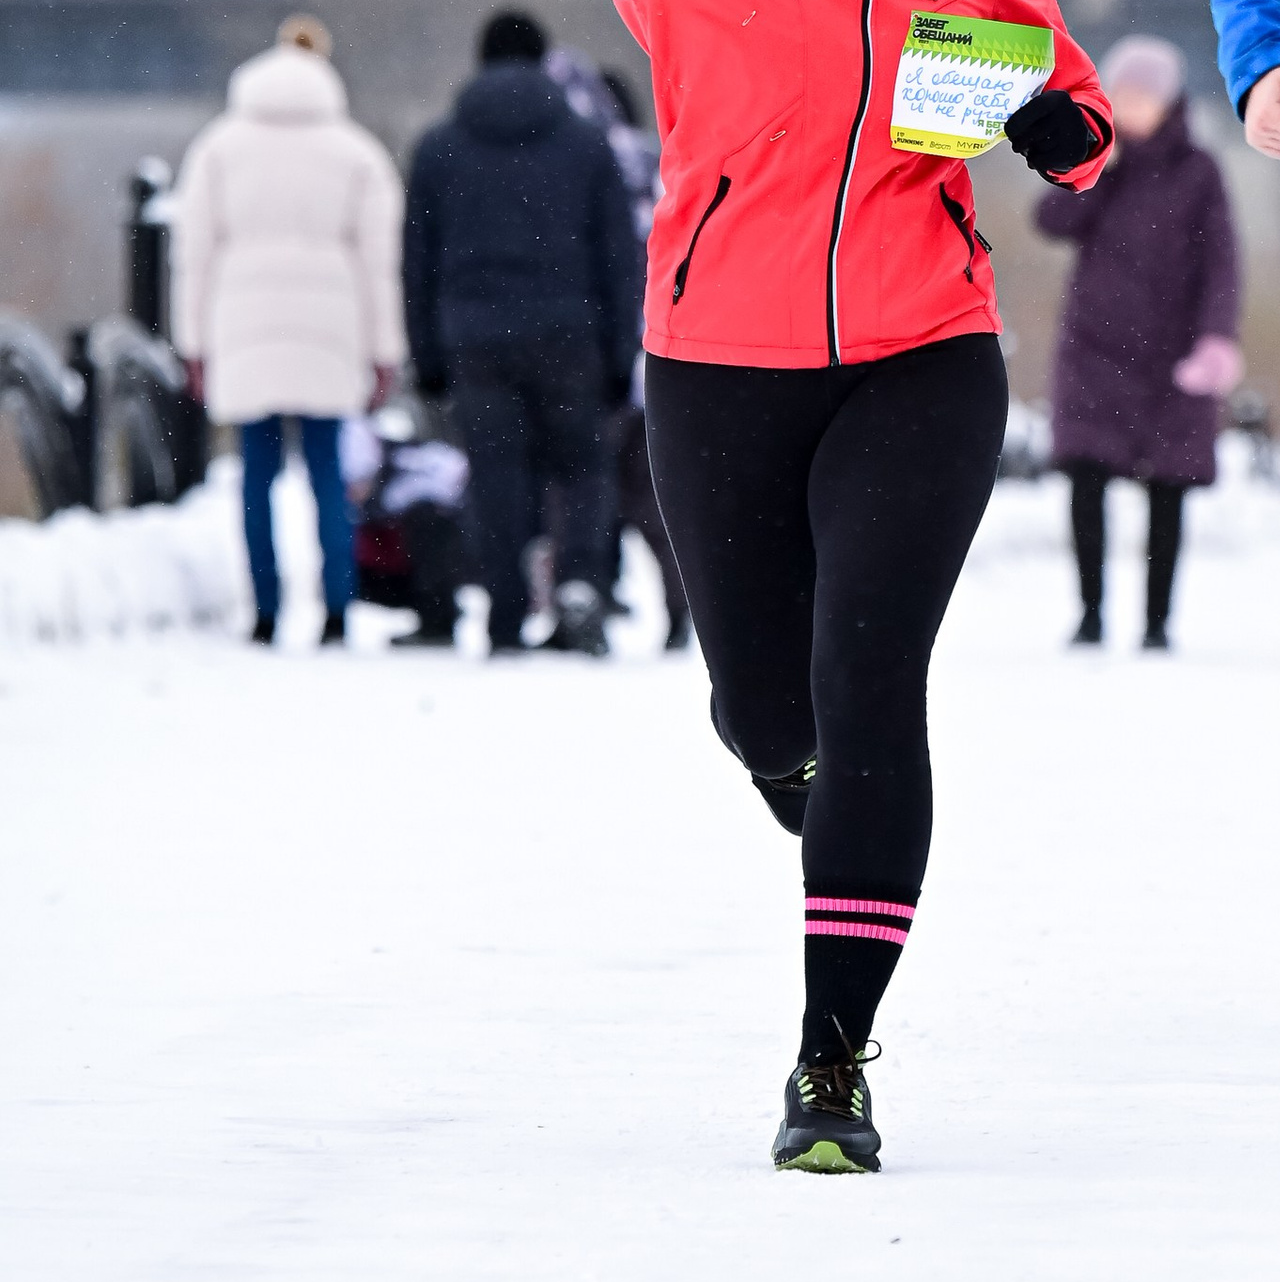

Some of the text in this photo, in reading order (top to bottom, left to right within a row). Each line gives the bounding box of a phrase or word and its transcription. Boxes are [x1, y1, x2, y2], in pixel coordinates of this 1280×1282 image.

[915, 17, 949, 30] ЗАБЕГ
[912, 28, 973, 46] ОБЕЩАНИЙ
[905, 67, 1014, 93] Я обещаю
[902, 87, 965, 108] хорошо
[935, 104, 956, 118] не
[896, 137, 924, 147] RUNNING
